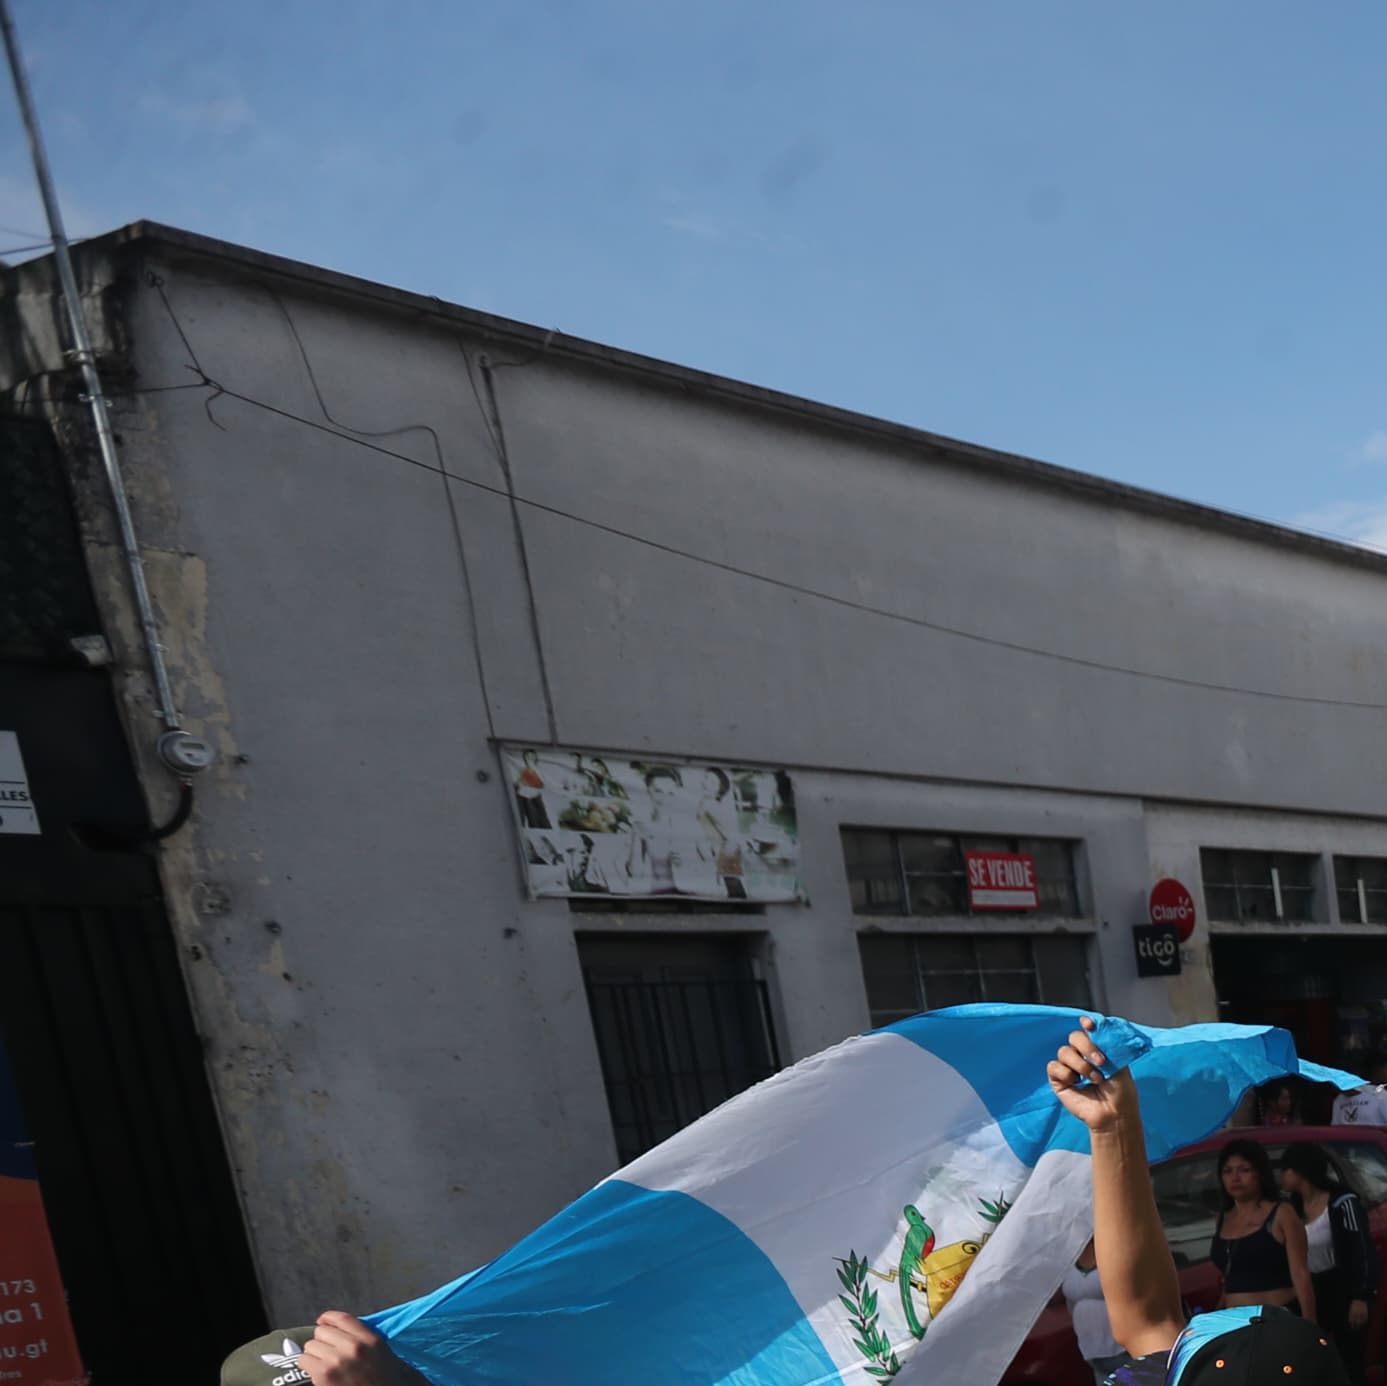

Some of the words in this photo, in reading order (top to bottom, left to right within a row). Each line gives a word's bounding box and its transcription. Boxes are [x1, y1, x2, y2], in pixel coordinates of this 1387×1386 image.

[968, 858, 986, 886] SE
[986, 859, 1034, 888] VENDE
[1151, 904, 1187, 921] Claro
